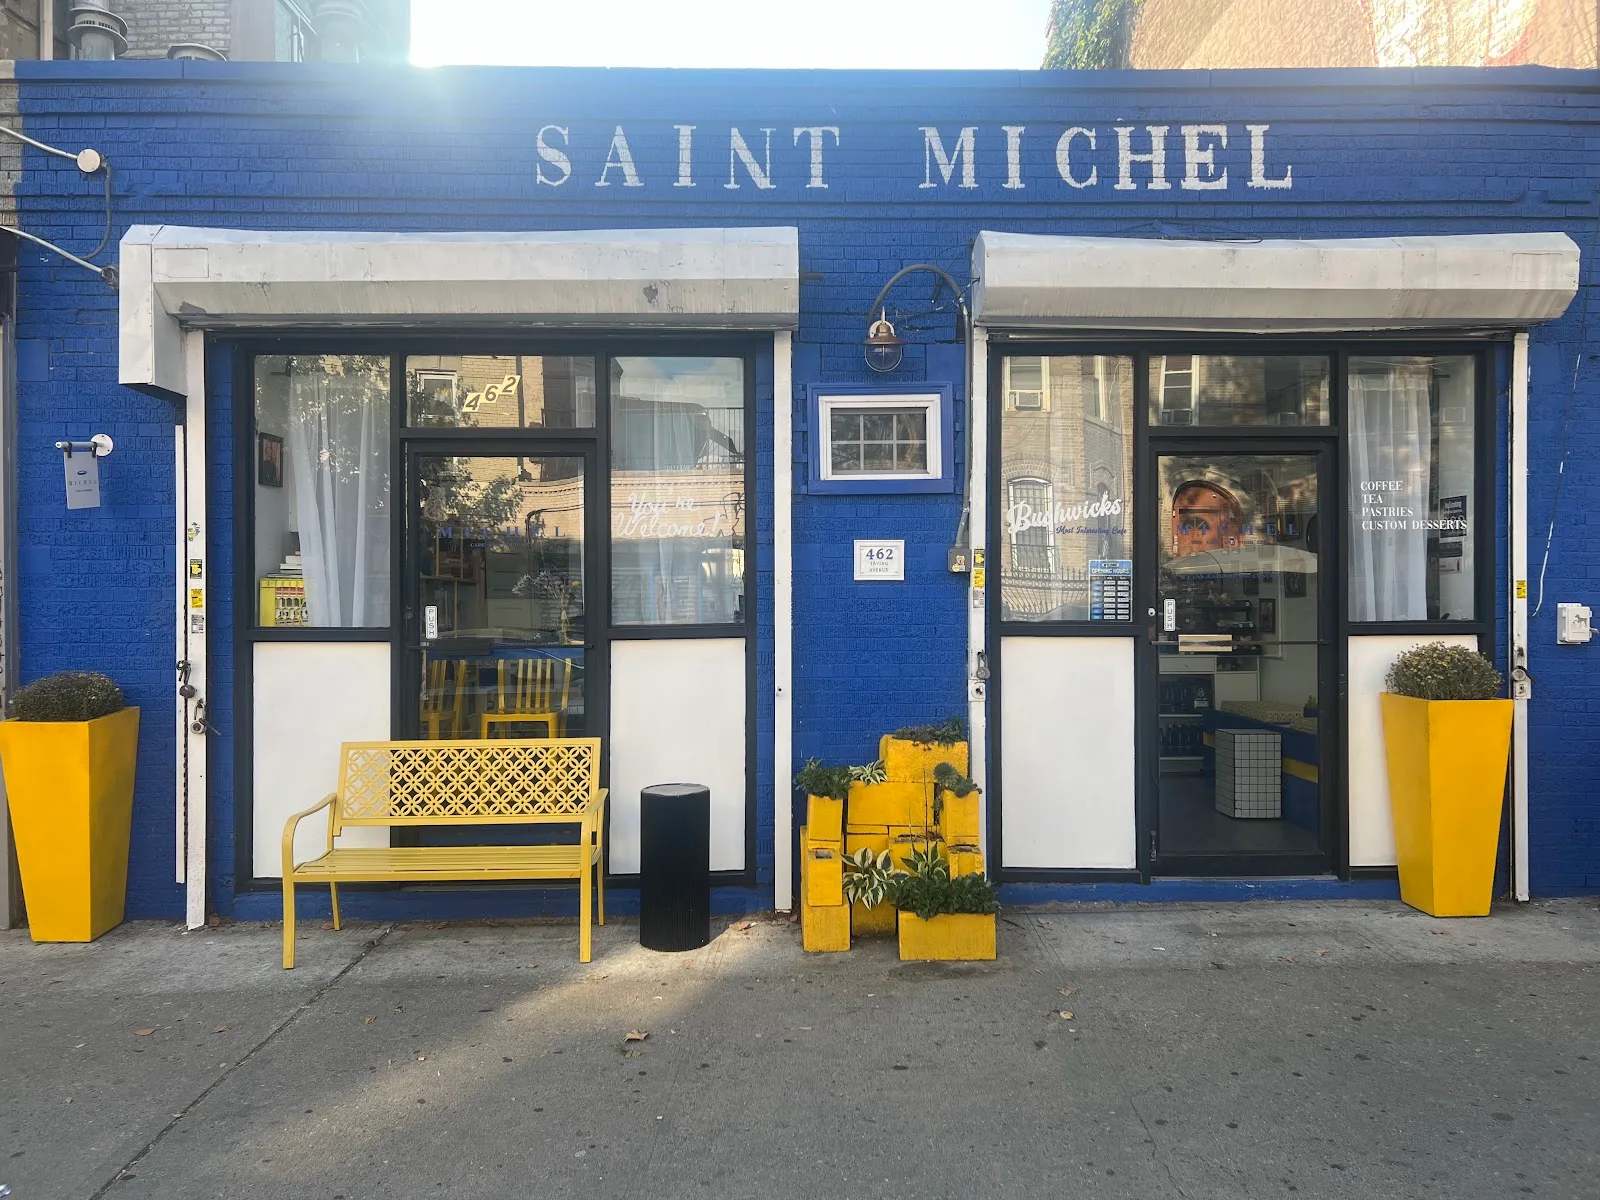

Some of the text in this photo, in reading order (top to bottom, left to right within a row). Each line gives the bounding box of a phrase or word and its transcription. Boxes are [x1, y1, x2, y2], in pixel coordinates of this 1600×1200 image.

[536, 124, 1293, 190] SAINT MICHEL
[465, 376, 517, 411] 462
[1360, 480, 1403, 491] COFFEE
[1362, 494, 1383, 504] TEA
[1006, 490, 1122, 534] Bushwicks
[1362, 507, 1414, 517] PASTRIES
[1056, 525, 1073, 535] Most
[1075, 525, 1109, 536] Interesting
[1176, 523, 1299, 536] MICHEL
[1362, 520, 1468, 531] CUSTOM DESSERTS
[865, 548, 894, 560] 462
